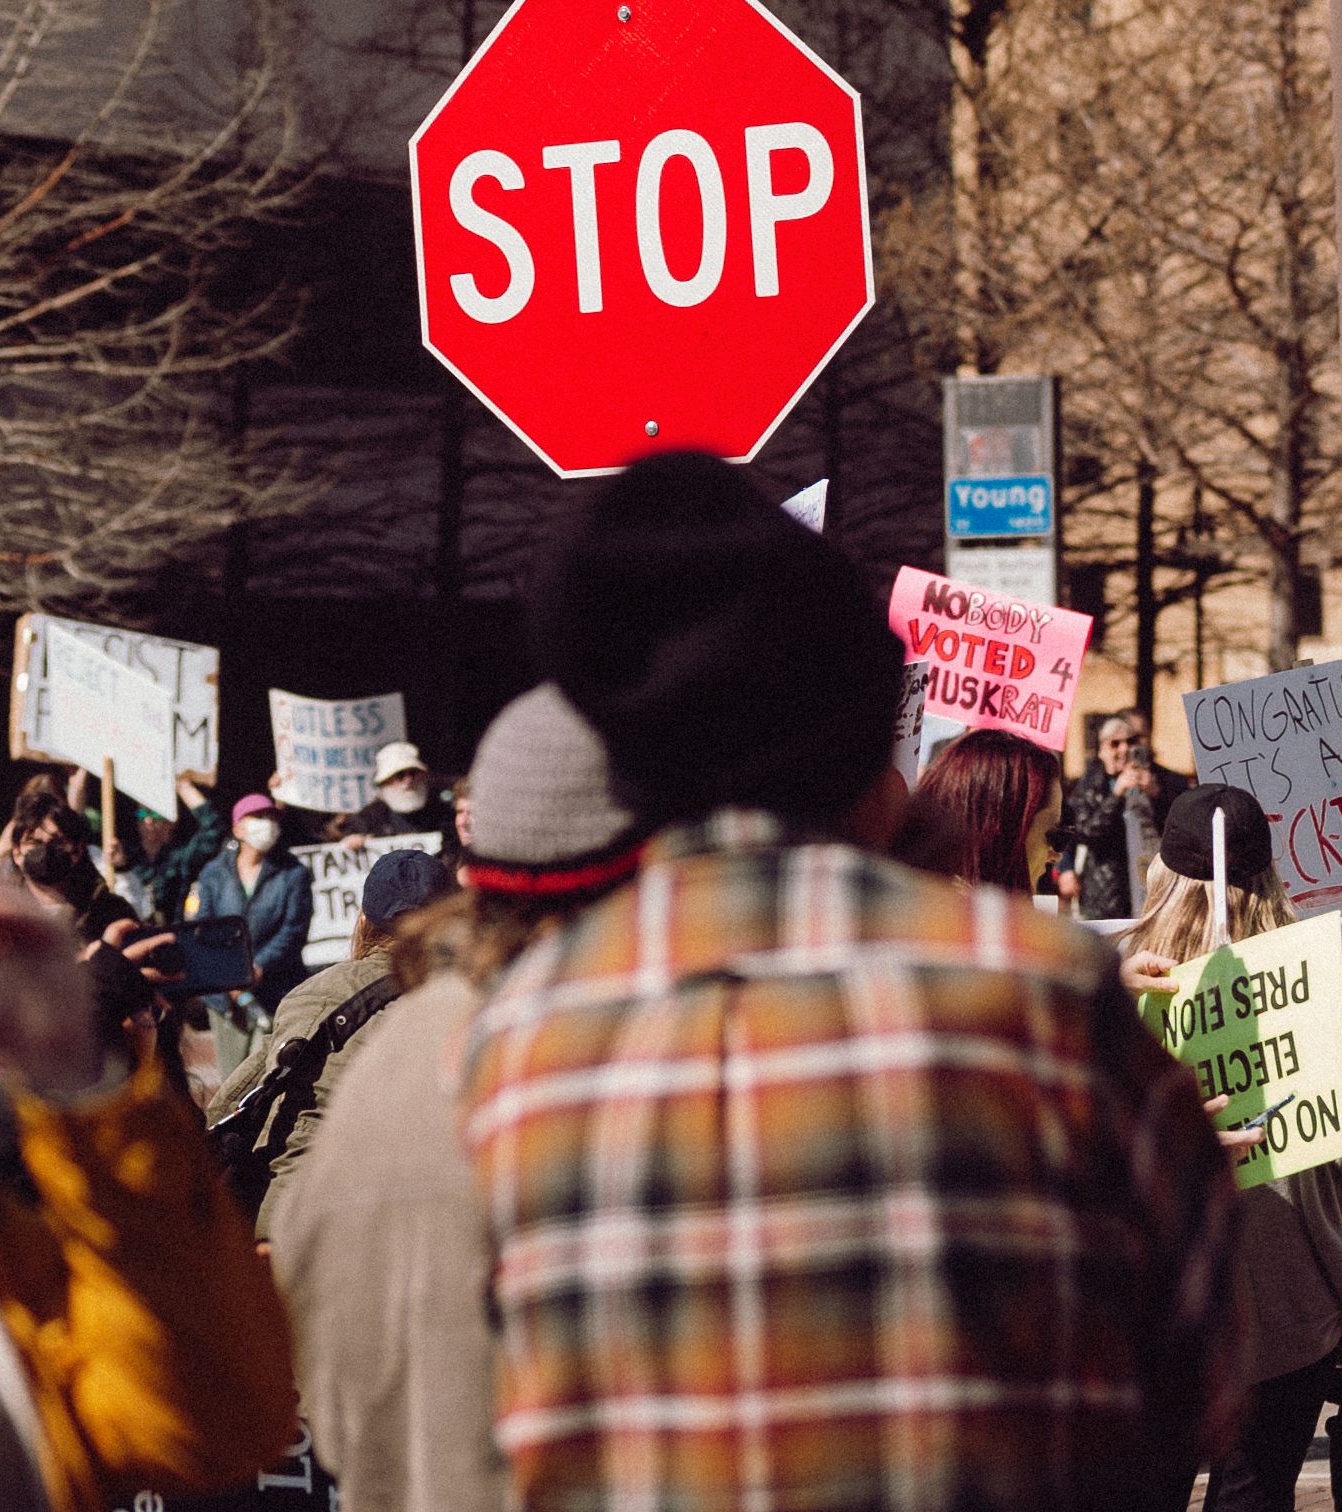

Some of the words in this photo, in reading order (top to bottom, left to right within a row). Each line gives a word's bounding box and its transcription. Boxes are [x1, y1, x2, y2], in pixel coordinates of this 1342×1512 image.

[448, 121, 835, 324] STOP
[954, 484, 1046, 514] Young
[921, 579, 1054, 645] NOBODY
[907, 617, 1036, 680] VOTED
[1050, 656, 1074, 693] 4
[927, 664, 1064, 734] MUSKRAT
[1161, 984, 1226, 1049] ELON
[1230, 959, 1310, 1020] PRES
[1196, 1030, 1300, 1099] ELECTE
[1295, 1089, 1341, 1143] NO
